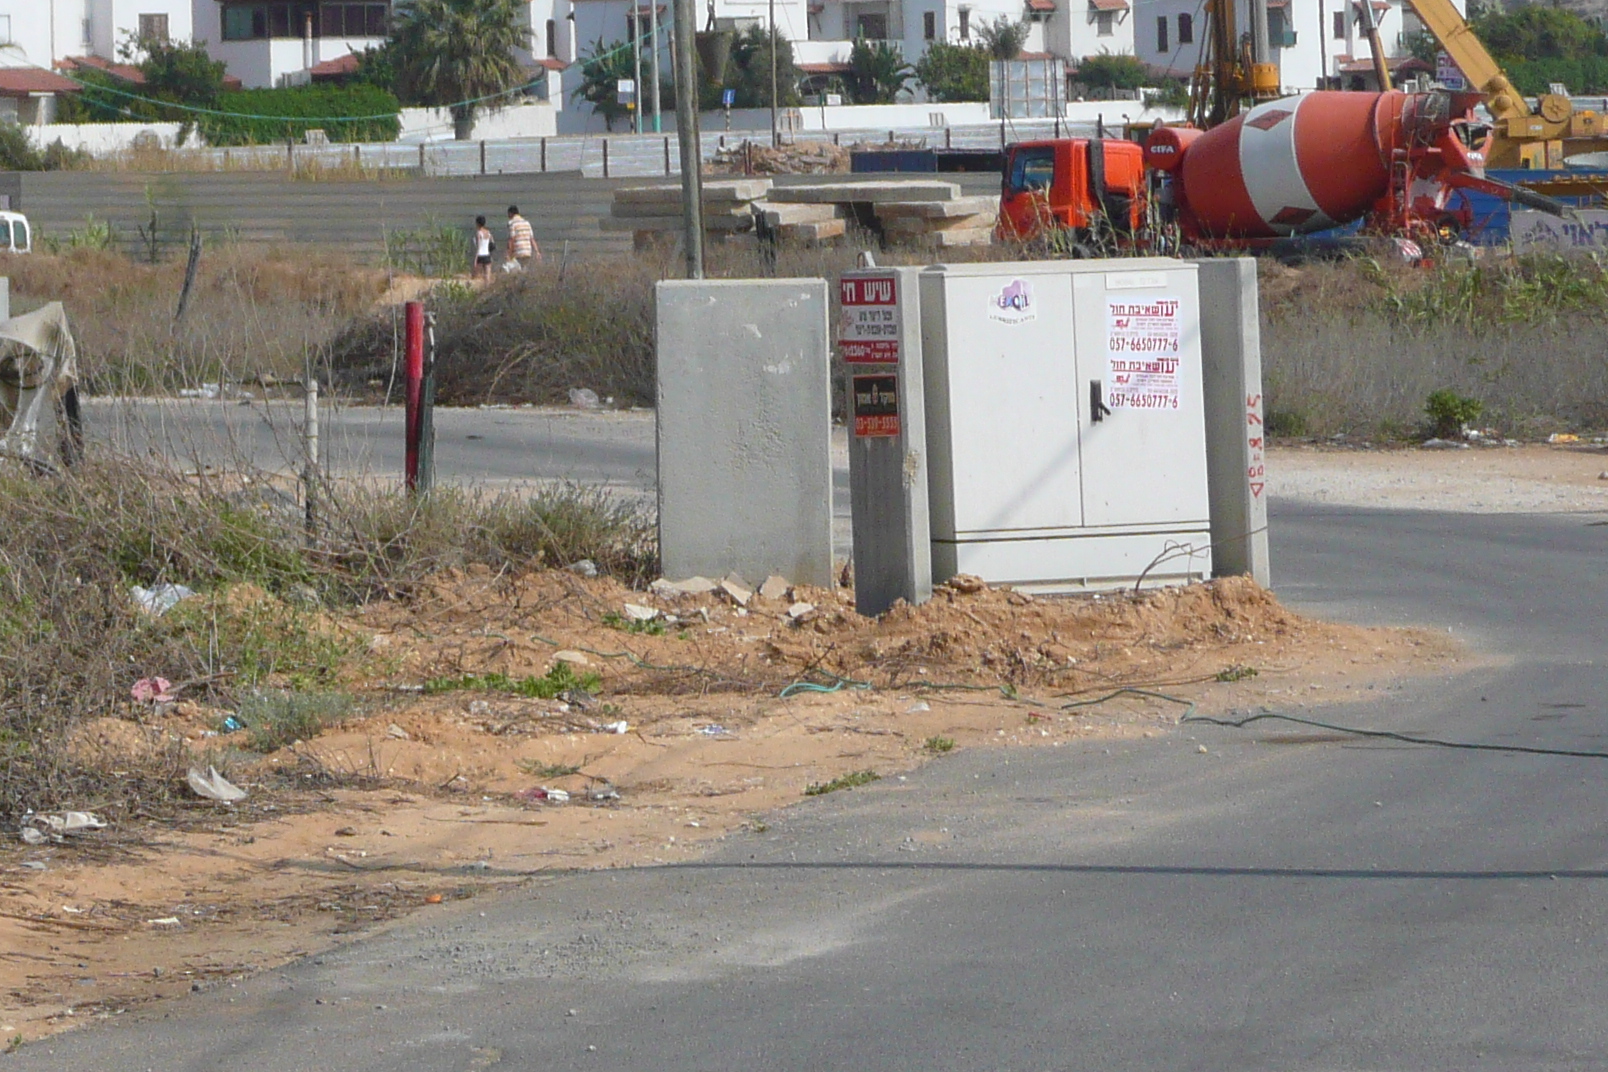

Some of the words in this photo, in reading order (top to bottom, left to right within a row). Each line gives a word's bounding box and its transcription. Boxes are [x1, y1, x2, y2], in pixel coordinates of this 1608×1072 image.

[1150, 145, 1174, 154] CIFA
[842, 281, 856, 302] חי
[864, 281, 891, 302] שיש
